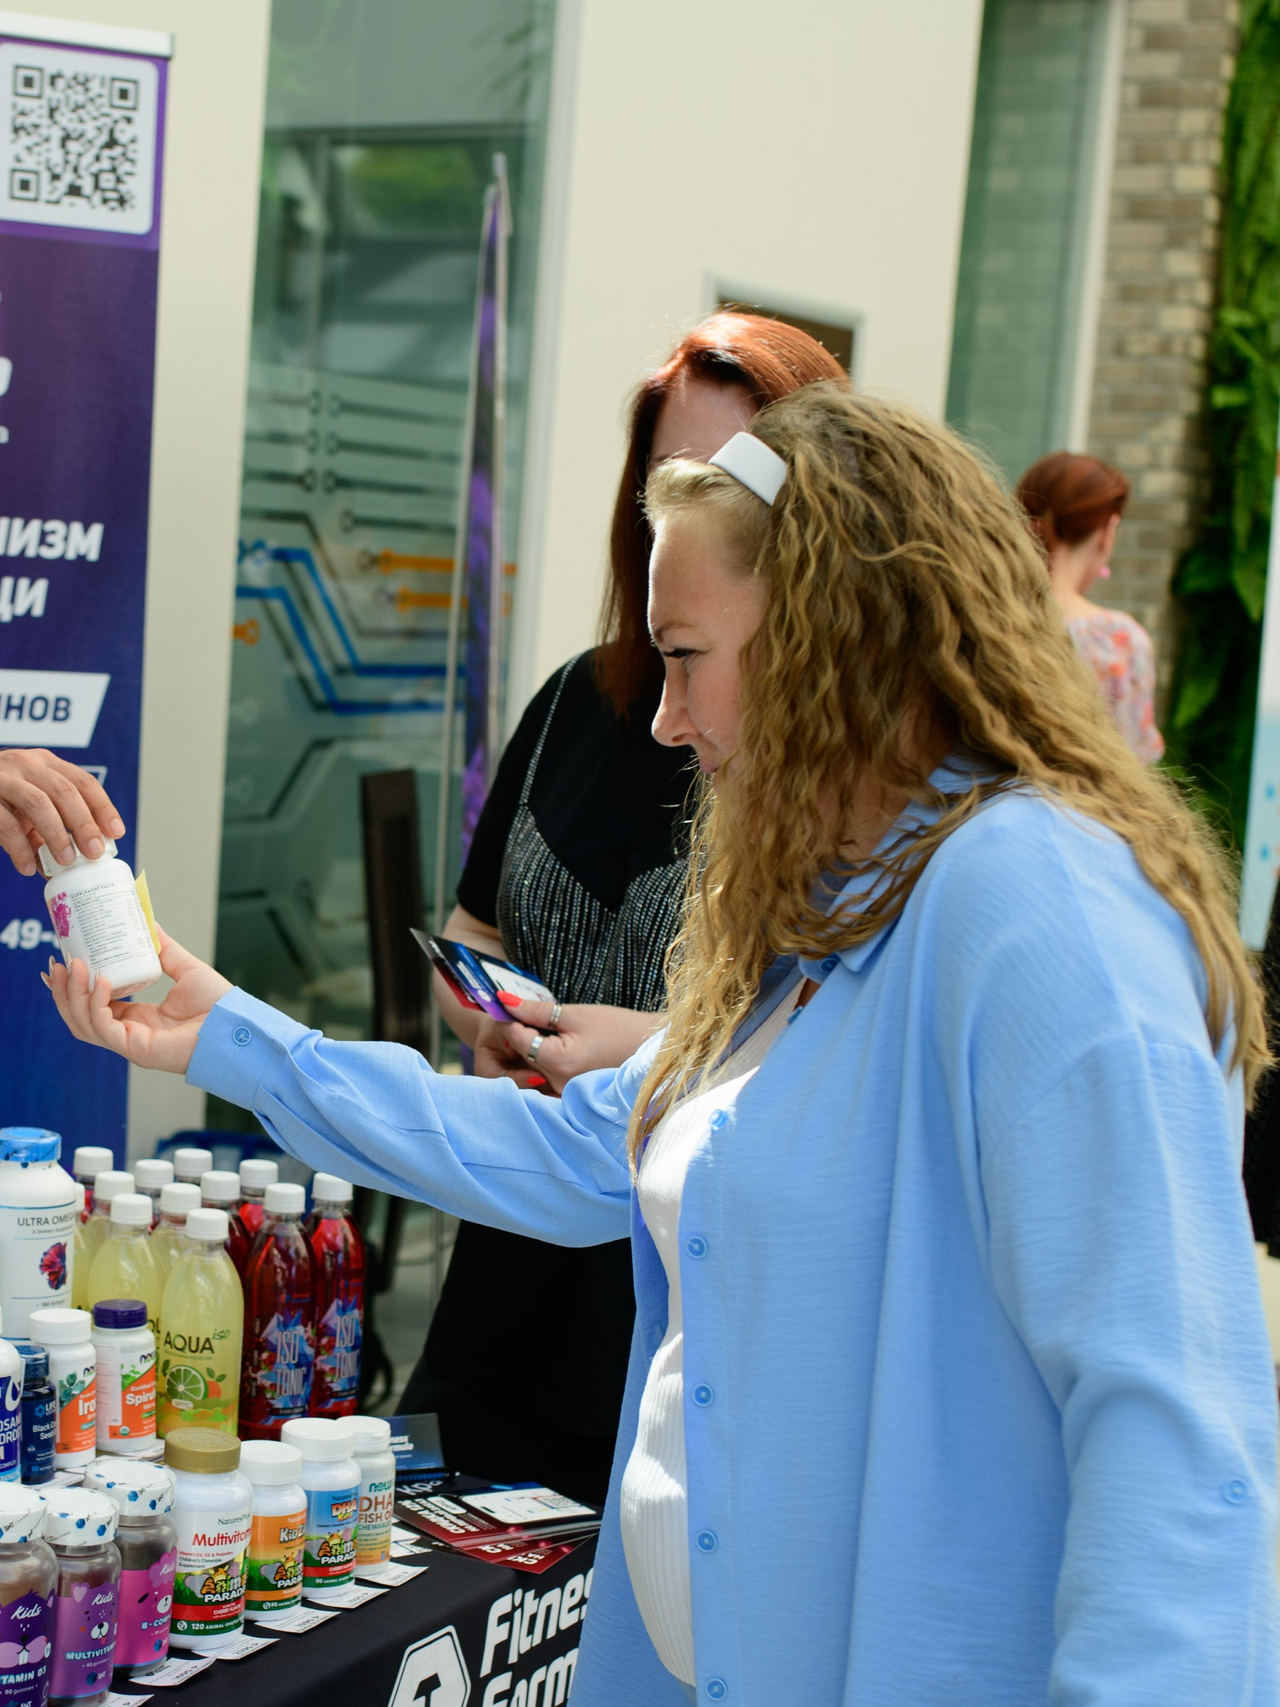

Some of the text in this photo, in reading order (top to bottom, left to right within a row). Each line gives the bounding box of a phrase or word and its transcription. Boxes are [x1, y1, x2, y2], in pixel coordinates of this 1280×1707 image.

[17, 1216, 50, 1227] ULTRA
[163, 1334, 215, 1355] AQUA
[213, 1328, 231, 1341] iso
[335, 1315, 357, 1350] ISO
[276, 1330, 301, 1365] ISO
[275, 1366, 307, 1397] TONIC
[331, 1498, 358, 1518] DHA
[91, 1591, 115, 1606] Kids
[10, 1603, 42, 1620] Kids
